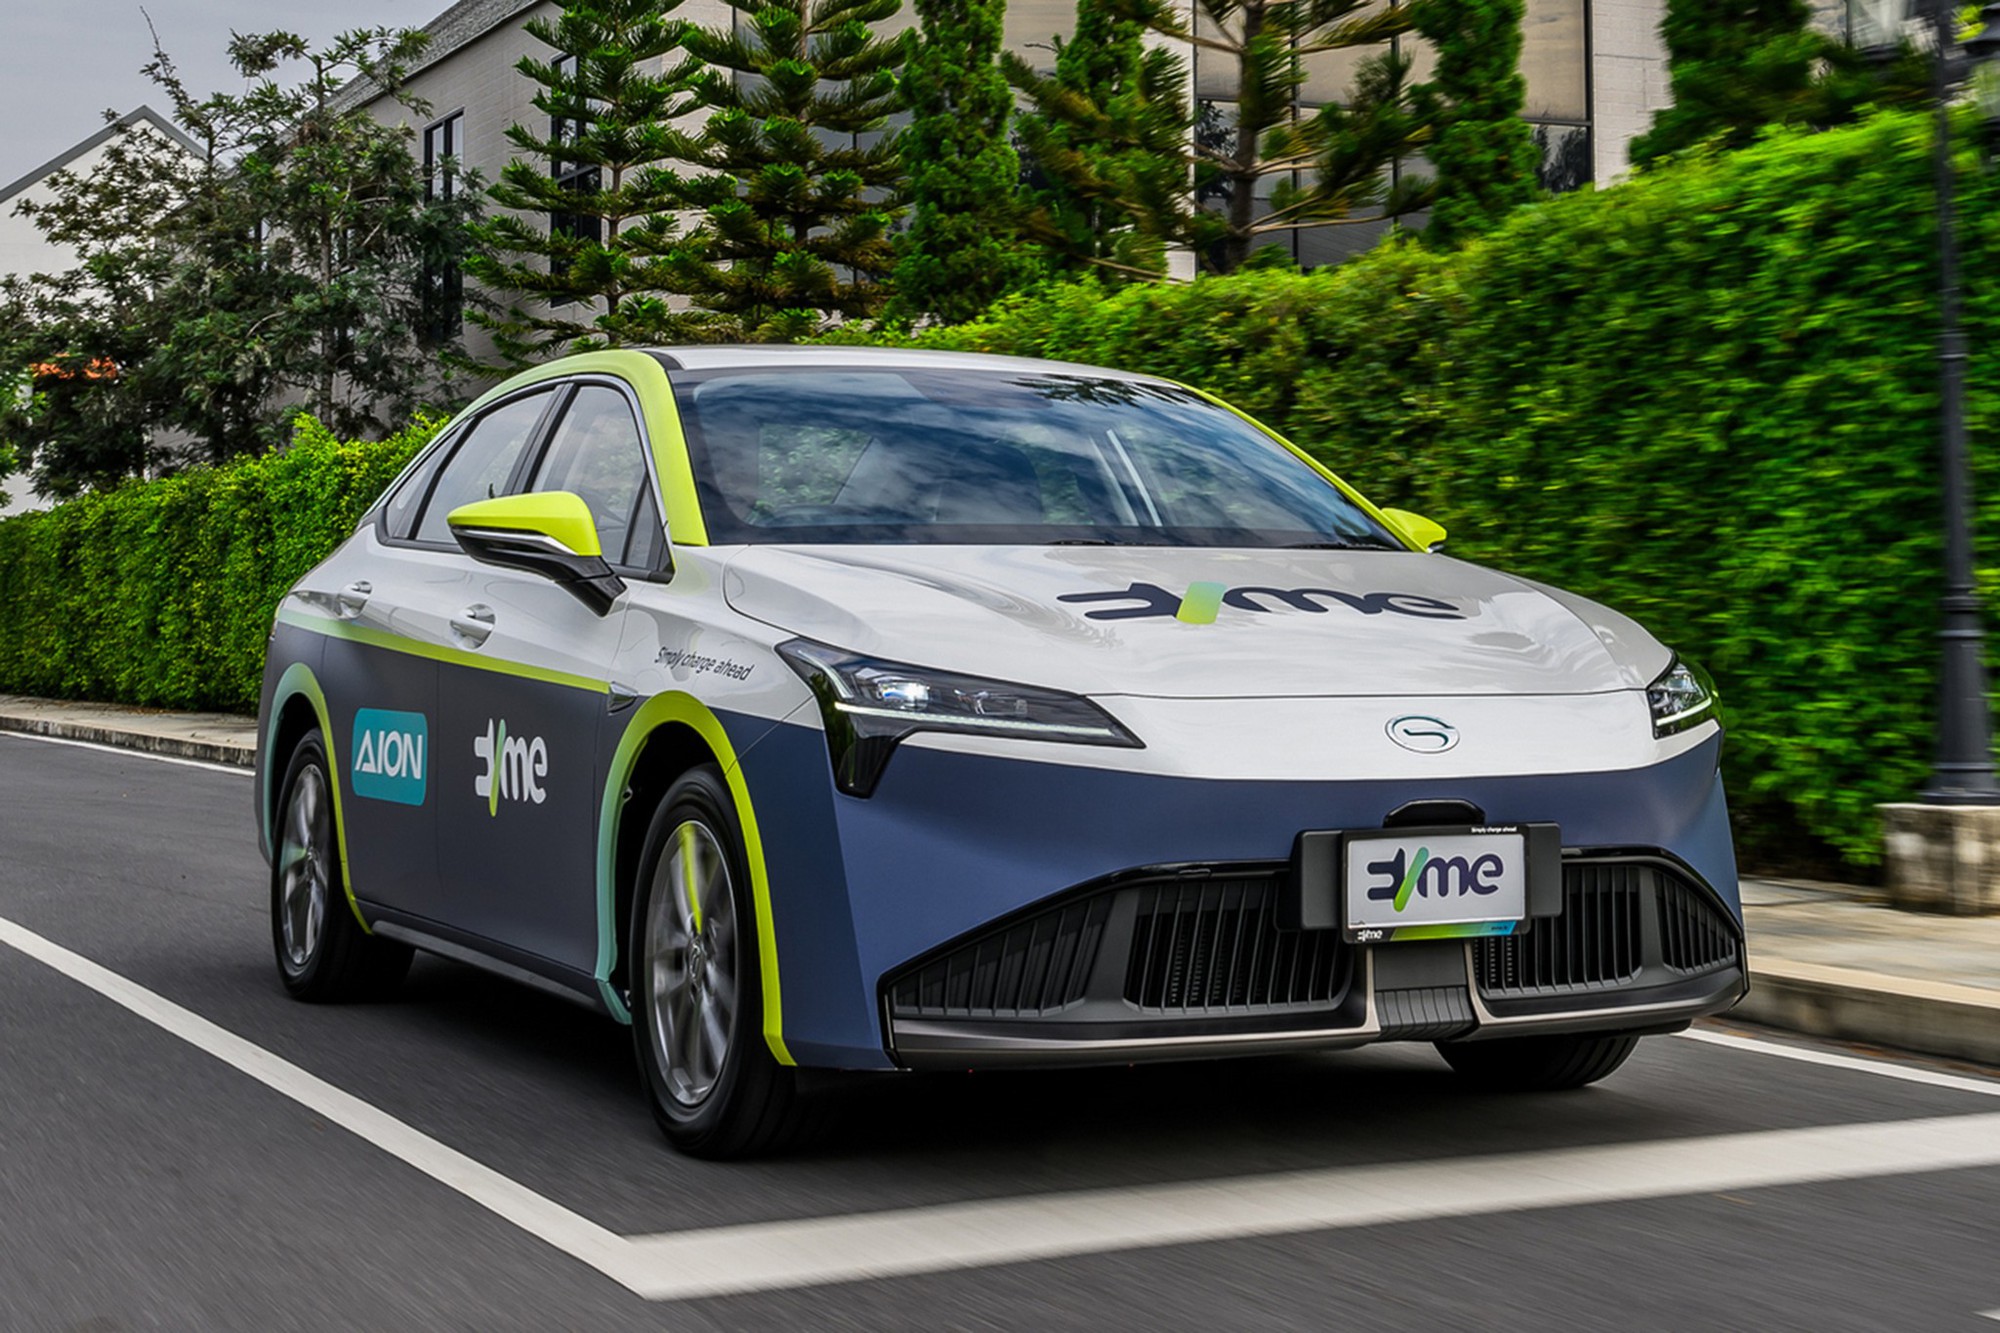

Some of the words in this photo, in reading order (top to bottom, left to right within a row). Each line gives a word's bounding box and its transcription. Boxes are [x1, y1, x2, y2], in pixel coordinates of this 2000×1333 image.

[654, 646, 685, 670] Simply
[681, 651, 716, 674] charge
[713, 658, 755, 681] ahead
[355, 729, 423, 780] AION
